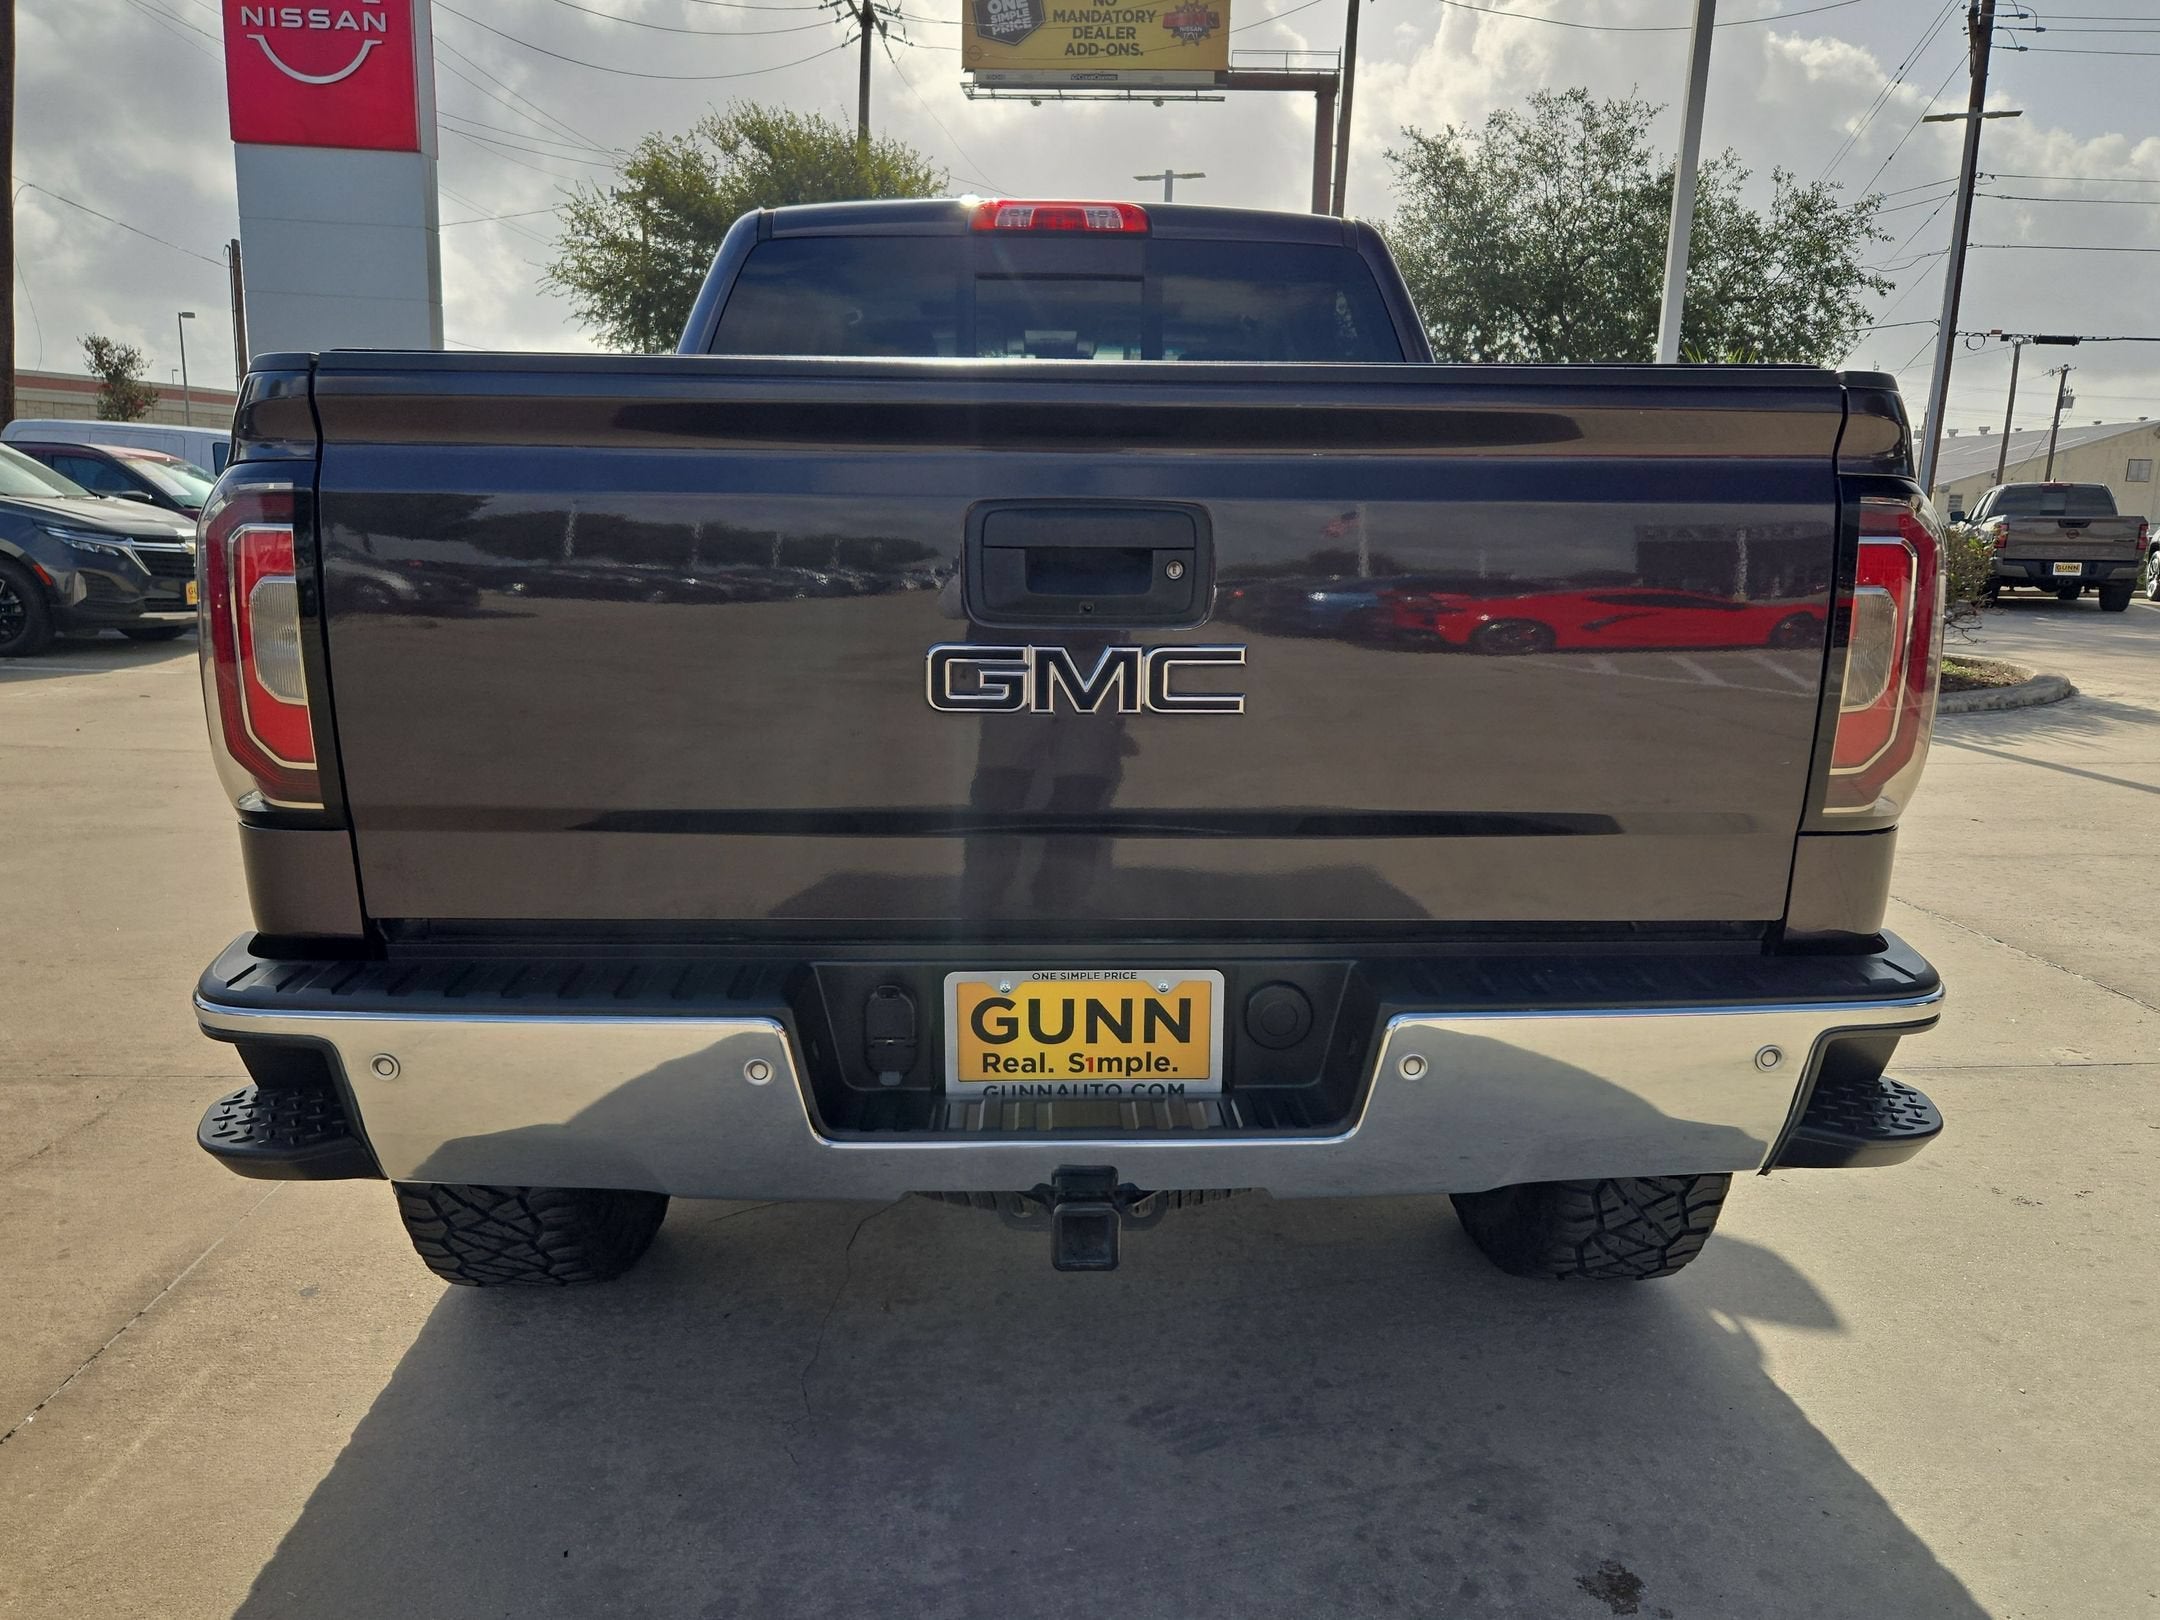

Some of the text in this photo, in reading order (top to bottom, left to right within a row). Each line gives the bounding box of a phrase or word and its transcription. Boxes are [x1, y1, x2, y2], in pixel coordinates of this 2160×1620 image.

[241, 6, 387, 33] NISSAN
[990, 7, 1031, 23] SIMPLE
[1053, 9, 1157, 23] MANDATORY
[991, 16, 1033, 35] PRICE
[1072, 26, 1137, 40] DEALER
[1064, 42, 1144, 56] ADD-ONS.
[927, 643, 1247, 714] GMC
[1032, 971, 1137, 980] ONE SIMPLE PRICE
[970, 997, 1191, 1045] GUNN
[982, 1052, 1054, 1073] Real.
[983, 1083, 1185, 1096] GUNNAUTOCOM
